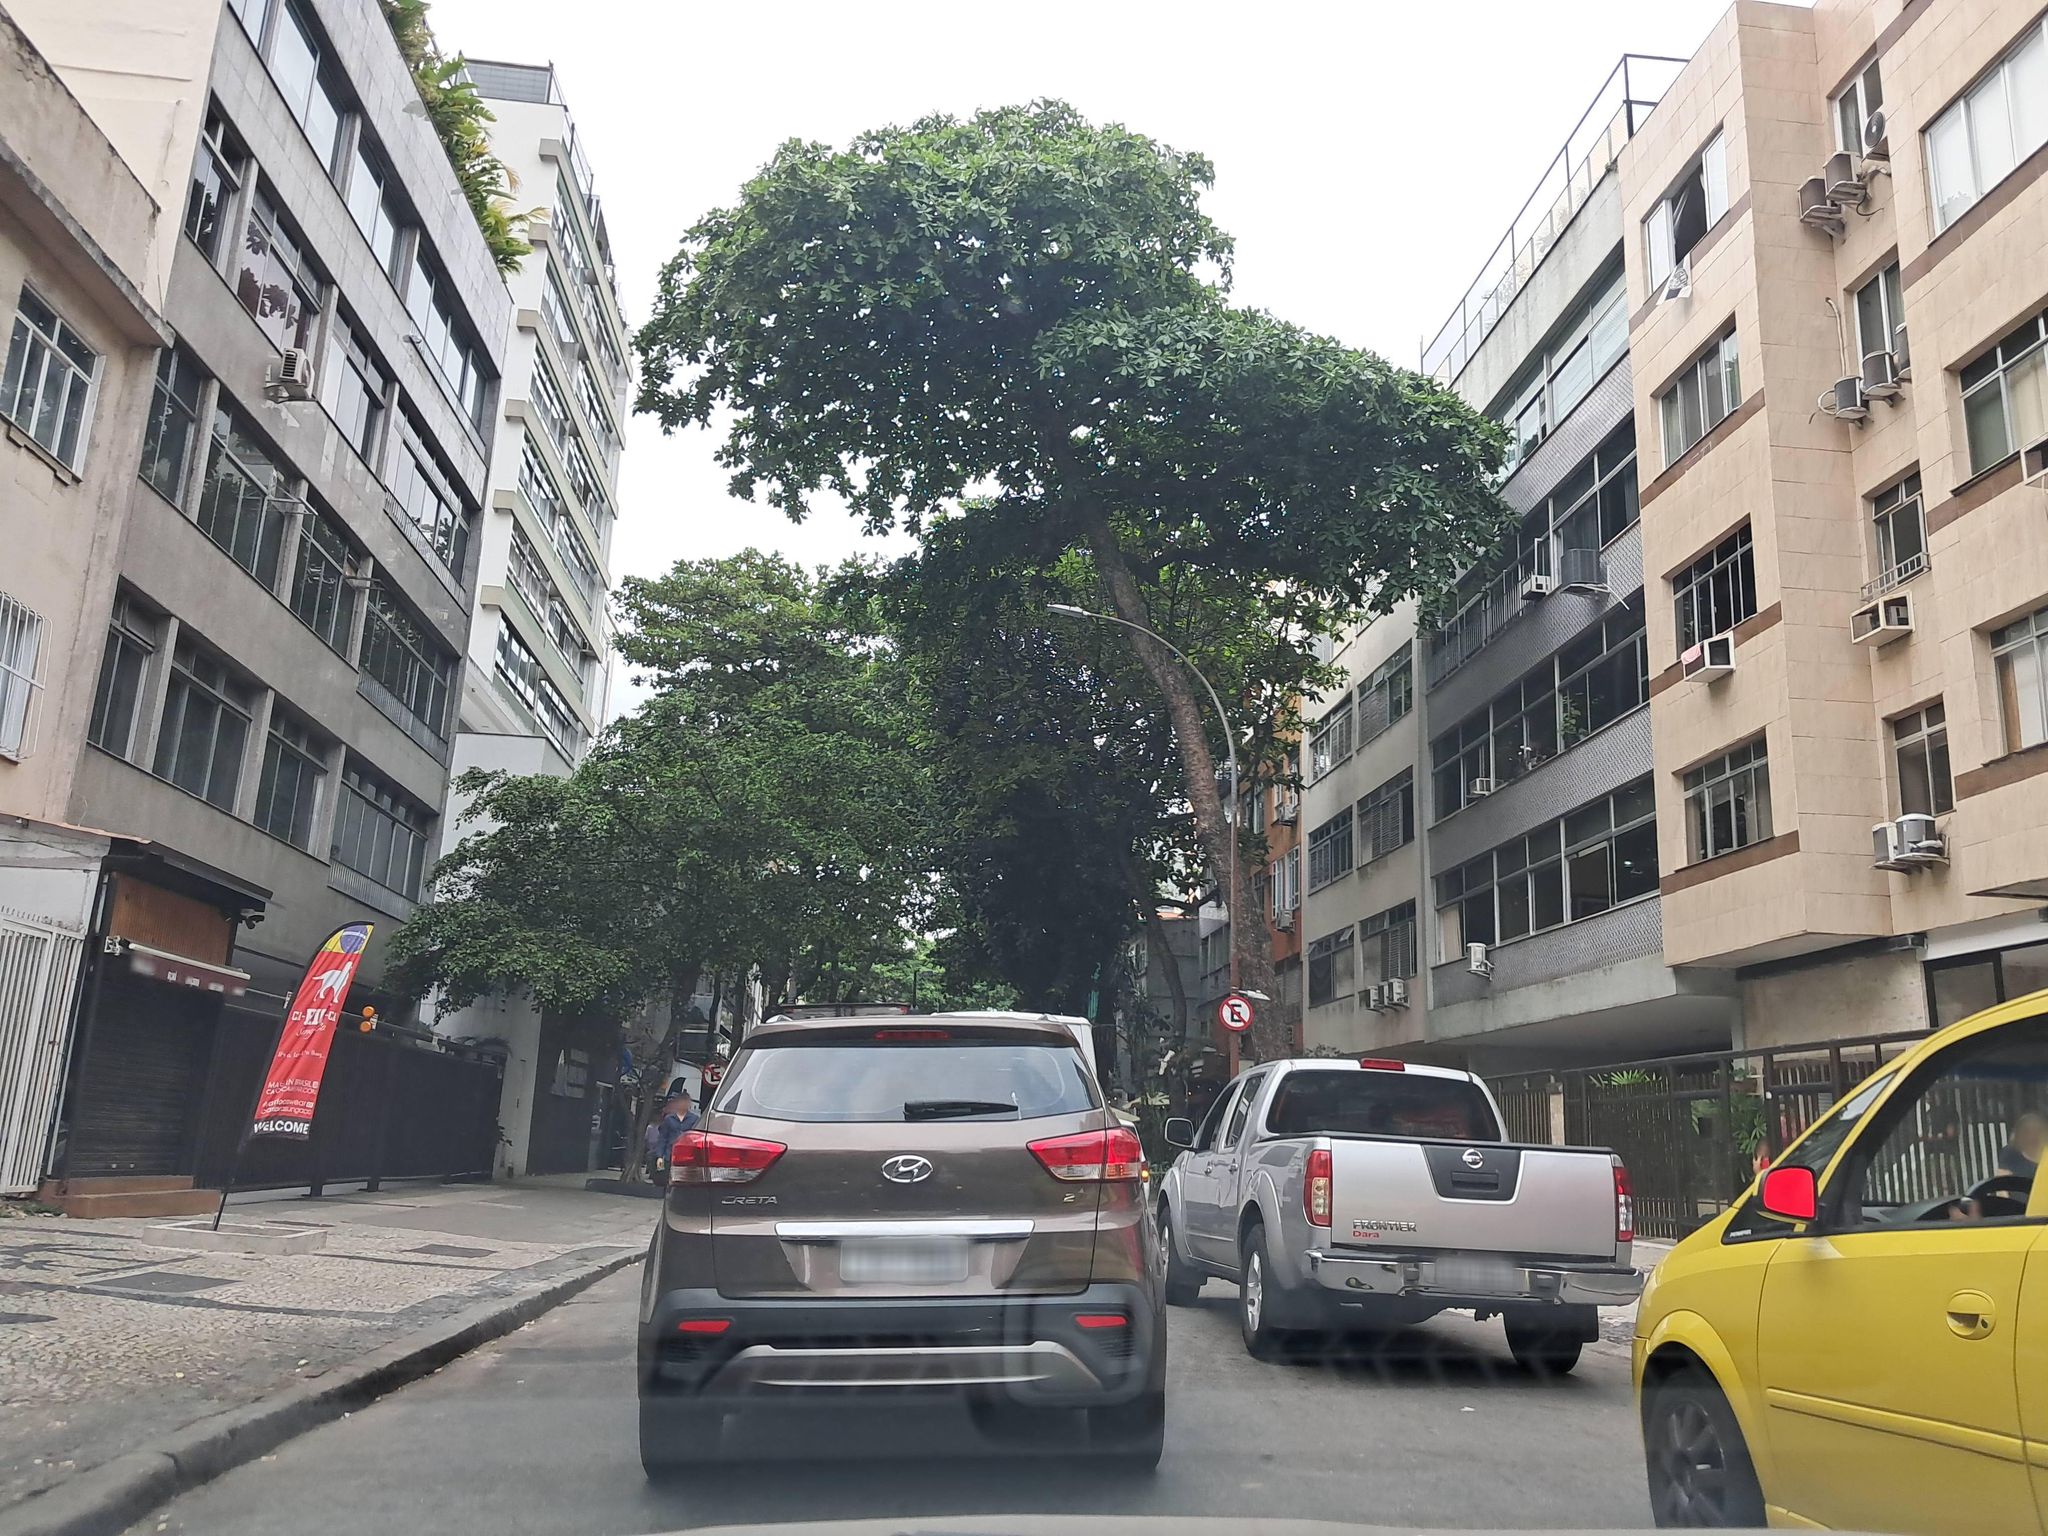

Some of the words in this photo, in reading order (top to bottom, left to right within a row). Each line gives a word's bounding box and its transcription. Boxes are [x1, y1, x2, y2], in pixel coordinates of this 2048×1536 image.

[1230, 1004, 1242, 1022] E
[254, 1120, 310, 1135] WELCOME
[721, 1195, 778, 1205] CRETA
[1352, 1218, 1418, 1233] FRONTIER
[1352, 1230, 1380, 1239] Dara
